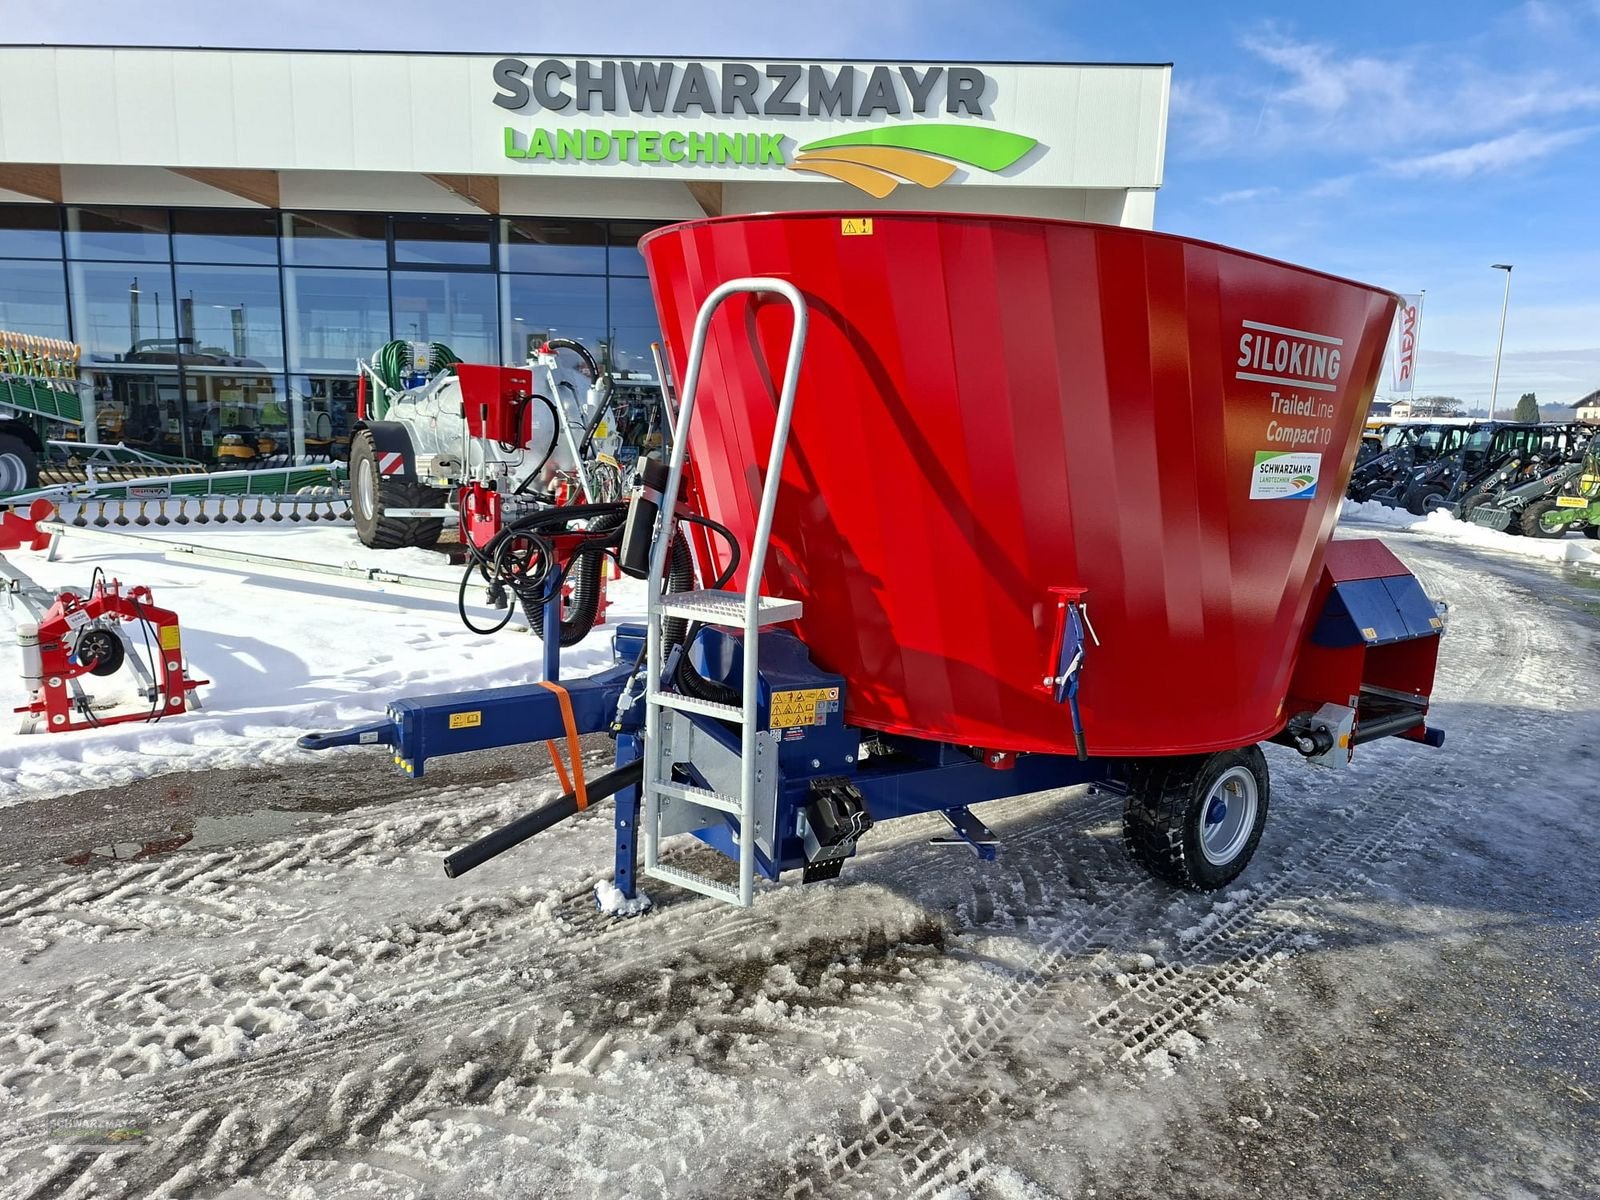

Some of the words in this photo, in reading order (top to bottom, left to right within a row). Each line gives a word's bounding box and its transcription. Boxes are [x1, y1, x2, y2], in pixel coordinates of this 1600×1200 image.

[492, 58, 986, 116] SCHWARZMAYR
[503, 127, 785, 165] LANDTECHNIK
[1237, 333, 1341, 380] SILOKING
[1271, 392, 1334, 418] TrailedLine
[1267, 420, 1319, 448] Compact
[1320, 427, 1332, 445] 10
[1260, 463, 1312, 474] SCHWARZMAYR
